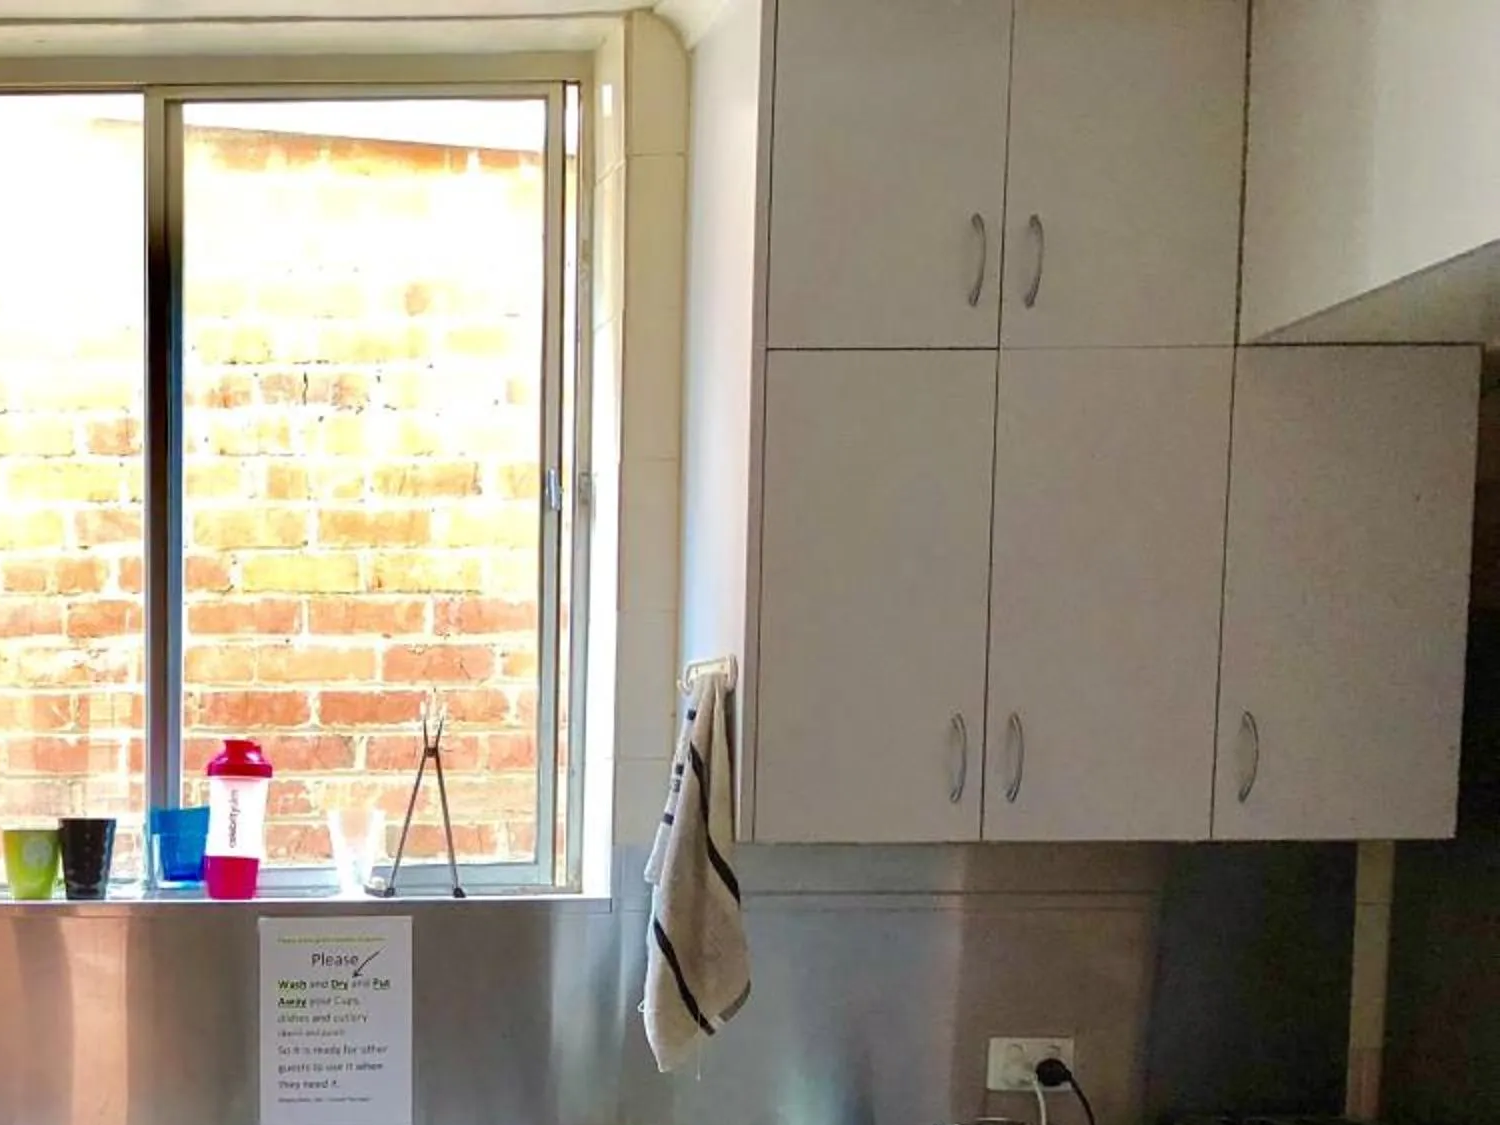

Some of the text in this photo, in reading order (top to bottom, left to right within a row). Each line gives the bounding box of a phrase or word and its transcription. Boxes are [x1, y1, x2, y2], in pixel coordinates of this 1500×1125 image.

[311, 952, 359, 967] Please
[278, 979, 307, 990] Wash
[310, 979, 329, 988] and
[331, 979, 348, 991] Dry
[372, 978, 390, 990] Put
[278, 997, 307, 1008] Away
[312, 1013, 330, 1022] and
